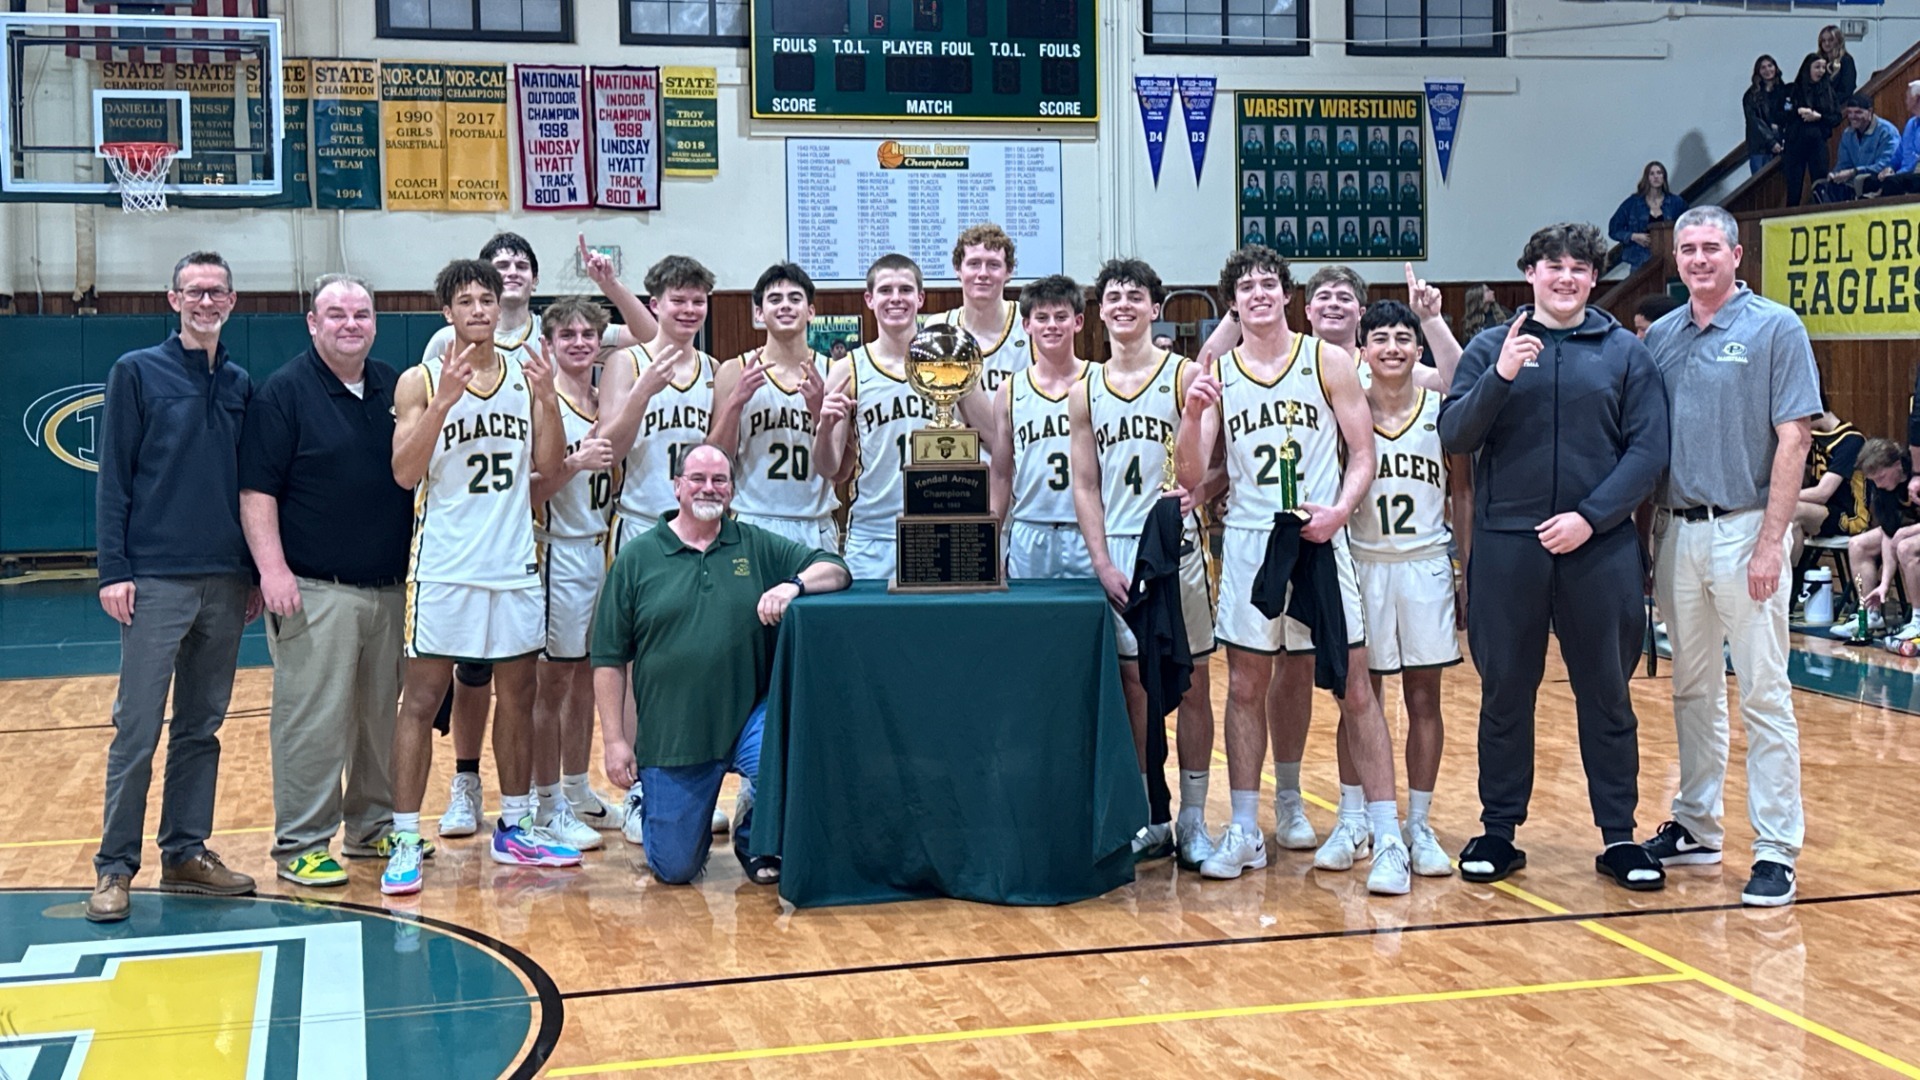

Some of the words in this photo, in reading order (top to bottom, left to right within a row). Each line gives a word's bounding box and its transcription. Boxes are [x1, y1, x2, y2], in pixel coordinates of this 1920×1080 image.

[773, 38, 817, 54] FOULS
[833, 40, 870, 55] T.O.L.
[882, 40, 933, 56] PLAYER
[941, 41, 975, 57] FOUL
[990, 42, 1026, 58] T.O.L.
[1039, 43, 1081, 58] FOULS
[103, 62, 164, 79] STATE
[175, 64, 235, 80] STATE
[316, 67, 374, 83] STATE
[383, 68, 443, 86] NOR-CAL
[446, 70, 505, 87] NOR-CAL
[522, 72, 580, 88] NATIONAL
[596, 75, 655, 90] NATIONAL
[666, 77, 715, 88] STATE
[104, 81, 165, 91] CHAMPION
[176, 82, 235, 93] CHAMPION
[316, 85, 375, 95] CHAMPION
[383, 87, 443, 97] CHAMPIONS
[666, 88, 714, 96] CHAMPION
[447, 89, 505, 98] CHAMPIONS
[528, 91, 576, 104] OUTDOOR
[607, 94, 646, 106] INDOOR
[104, 103, 166, 114] DANIELLE
[191, 104, 229, 115] NISSF
[328, 106, 364, 117] CNISF
[772, 98, 817, 114] SCORE
[906, 100, 953, 115] MATCH
[1039, 101, 1081, 116] SCORE
[1243, 98, 1315, 119] VARSITY
[1320, 98, 1417, 119] WRESTLING
[396, 111, 433, 123] 1990
[457, 112, 495, 125] 2017
[528, 108, 579, 121] CHAMPION
[599, 109, 651, 121] CHAMPION
[109, 118, 163, 128] MCCORD
[331, 123, 363, 132] GIRLS
[396, 128, 433, 137] GIRLS
[450, 129, 505, 139] FOOTBALL
[538, 123, 569, 138] 1998
[614, 123, 643, 138] 1998
[1149, 131, 1163, 142] D4
[1191, 131, 1205, 142] D3
[331, 135, 364, 144] STATE
[386, 140, 445, 149] BASKETBALL
[677, 141, 705, 149] 2018
[1438, 140, 1450, 150] D4
[318, 148, 376, 157] CHAMPION
[528, 139, 580, 155] LINDSAY
[602, 139, 650, 155] LINDSAY
[333, 160, 363, 169] TEAM
[535, 157, 573, 172] HYATT
[608, 158, 645, 172] HYATT
[904, 157, 964, 169] Champions
[395, 178, 437, 188] COACH
[457, 180, 499, 189] COACH
[540, 174, 574, 187] TRACK
[610, 175, 643, 188] TRACK
[336, 189, 362, 199] 1994
[388, 190, 445, 200] MALLORY
[450, 191, 508, 201] MONTOYA
[535, 189, 560, 203] 800
[568, 188, 577, 202] M
[606, 189, 631, 204] 800
[637, 190, 646, 204] M
[1789, 223, 1853, 266] DEL
[1868, 218, 1920, 262] OR
[864, 394, 933, 433] PLACE
[750, 406, 816, 437] PLACE
[768, 442, 808, 481] 20
[1253, 441, 1304, 486] 22
[468, 452, 514, 494] 25
[1047, 452, 1069, 491] 3
[1124, 455, 1143, 495] 4
[915, 475, 947, 488] Kendall
[951, 475, 979, 488] Arnett
[589, 472, 611, 510] 10
[923, 489, 971, 499] Champions
[1377, 494, 1416, 535] 12
